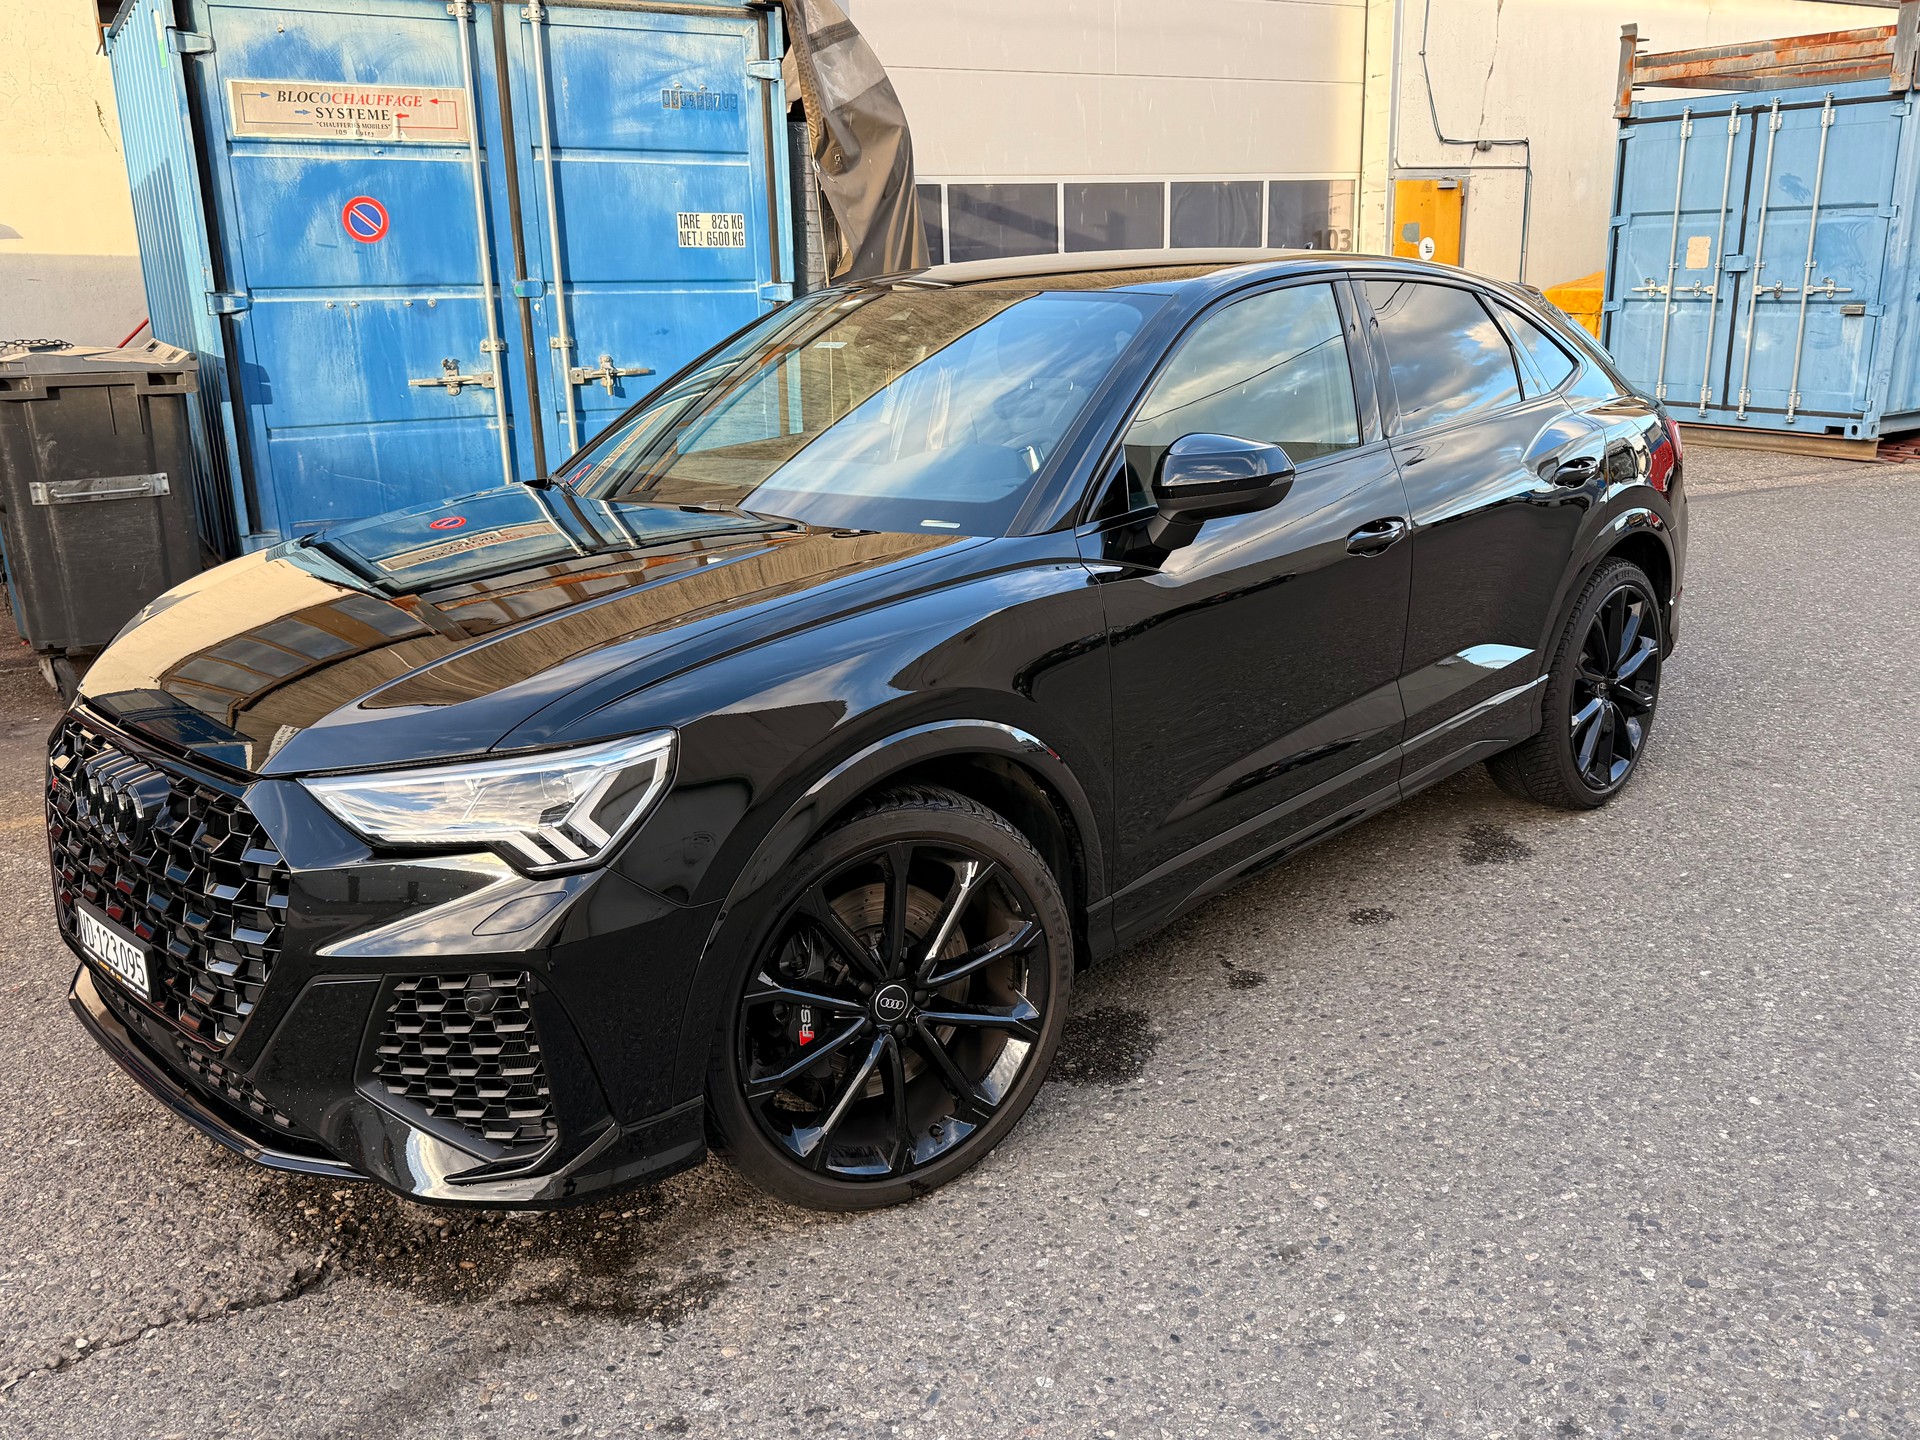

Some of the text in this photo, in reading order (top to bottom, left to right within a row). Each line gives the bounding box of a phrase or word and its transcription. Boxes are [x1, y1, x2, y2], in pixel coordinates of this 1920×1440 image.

[277, 90, 423, 107] BLOCOCHAUFFAGE
[315, 106, 390, 121] SYSTEME
[678, 214, 743, 230] TARE 825 KG
[679, 231, 696, 246] NET
[706, 231, 730, 246] 6500
[732, 231, 744, 246] KG
[1312, 229, 1351, 251] 103
